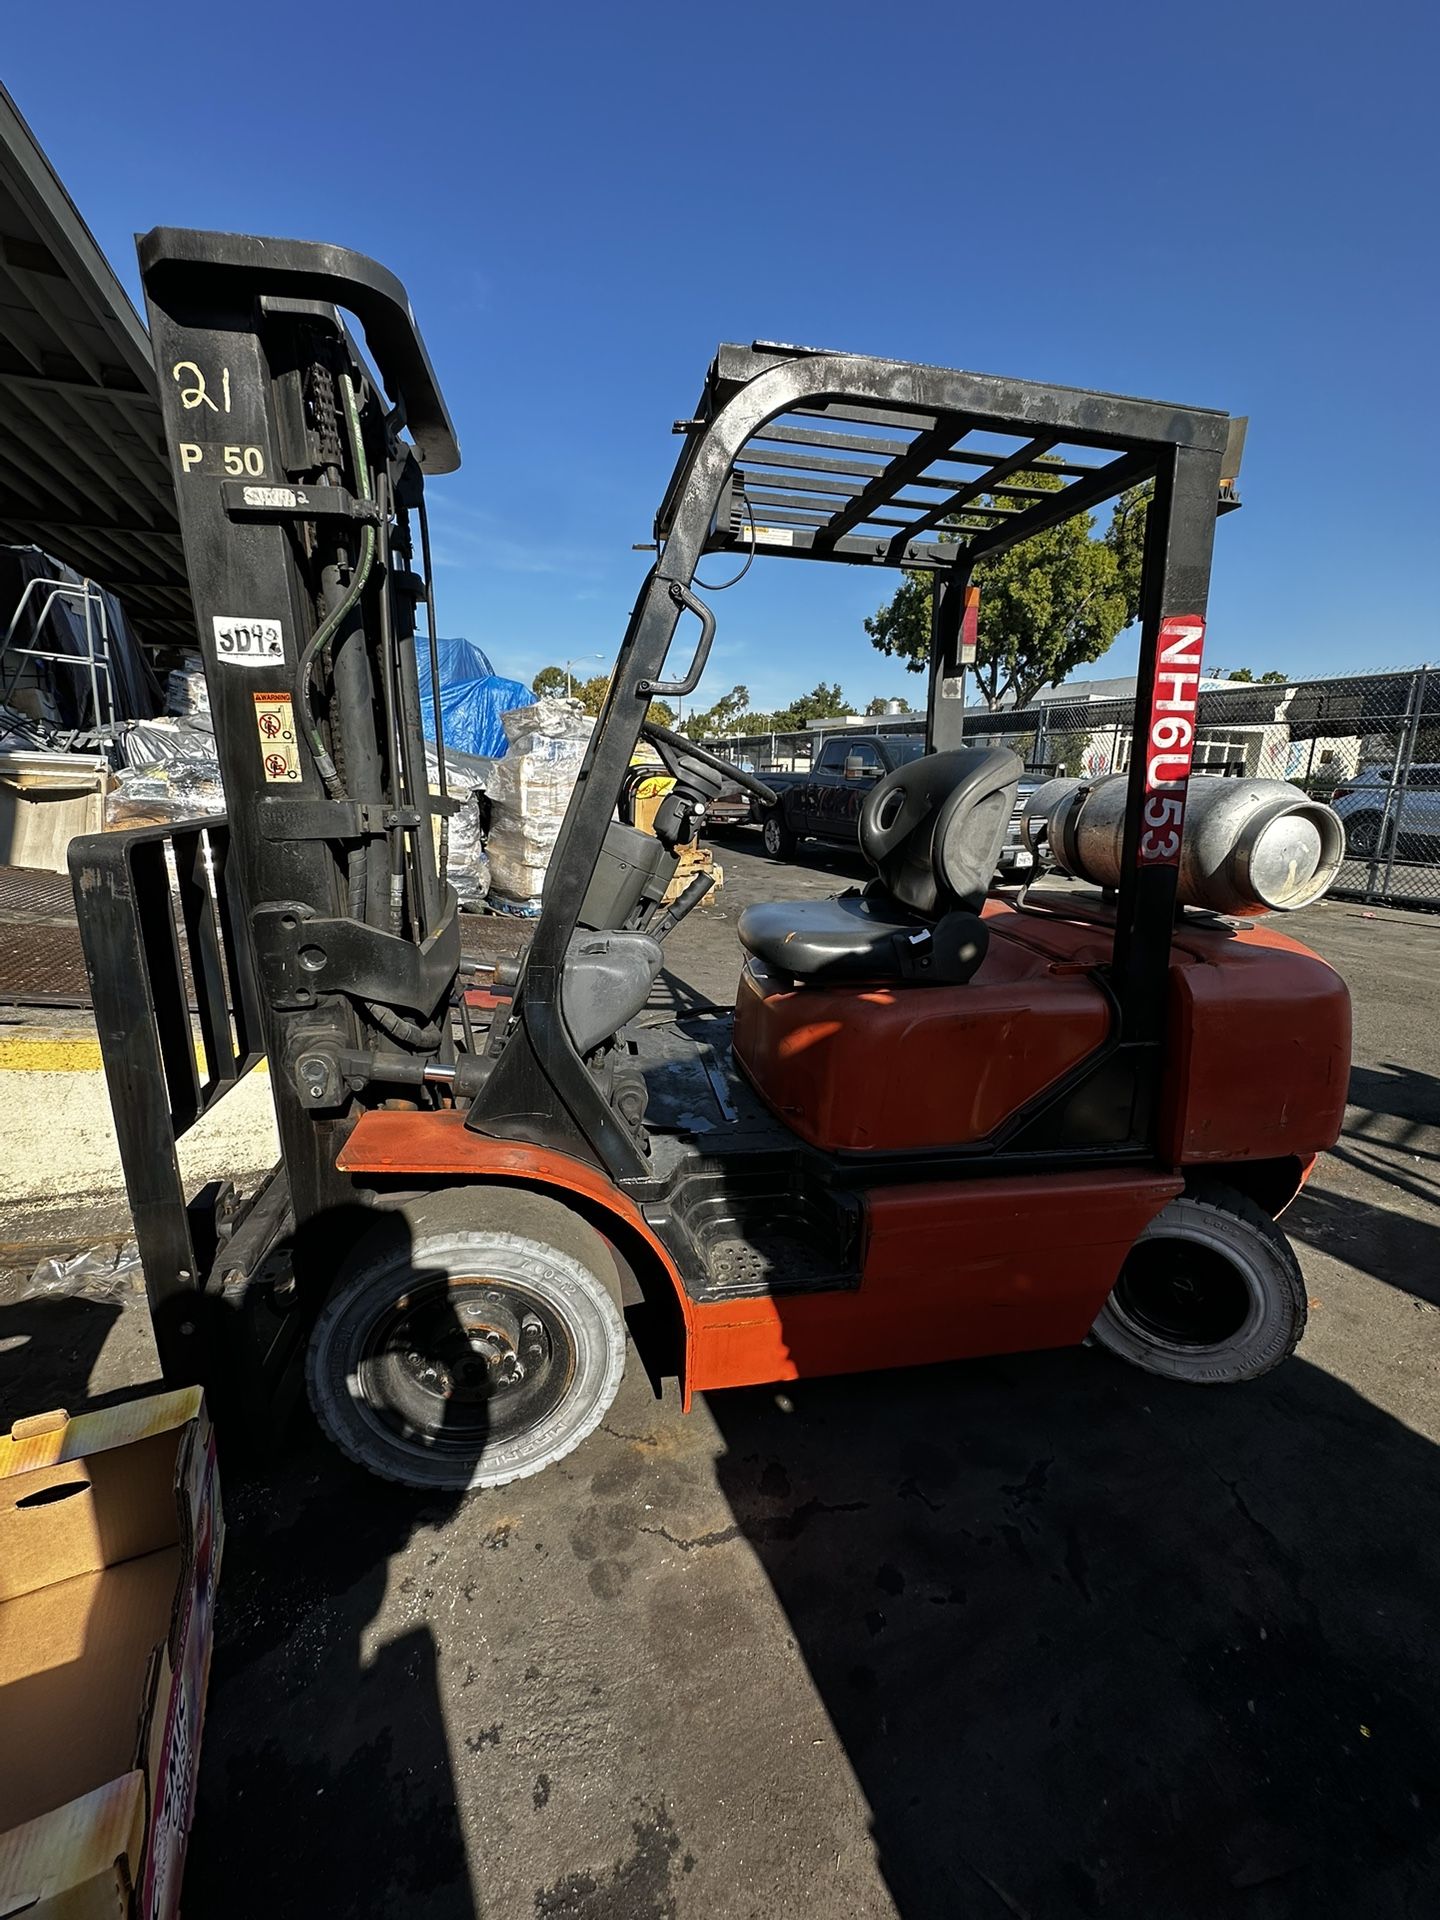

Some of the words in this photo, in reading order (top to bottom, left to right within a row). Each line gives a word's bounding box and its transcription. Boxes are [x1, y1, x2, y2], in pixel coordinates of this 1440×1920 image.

[173, 361, 231, 413] 21
[224, 446, 264, 476] 50
[1141, 625, 1203, 860] NH6U53
